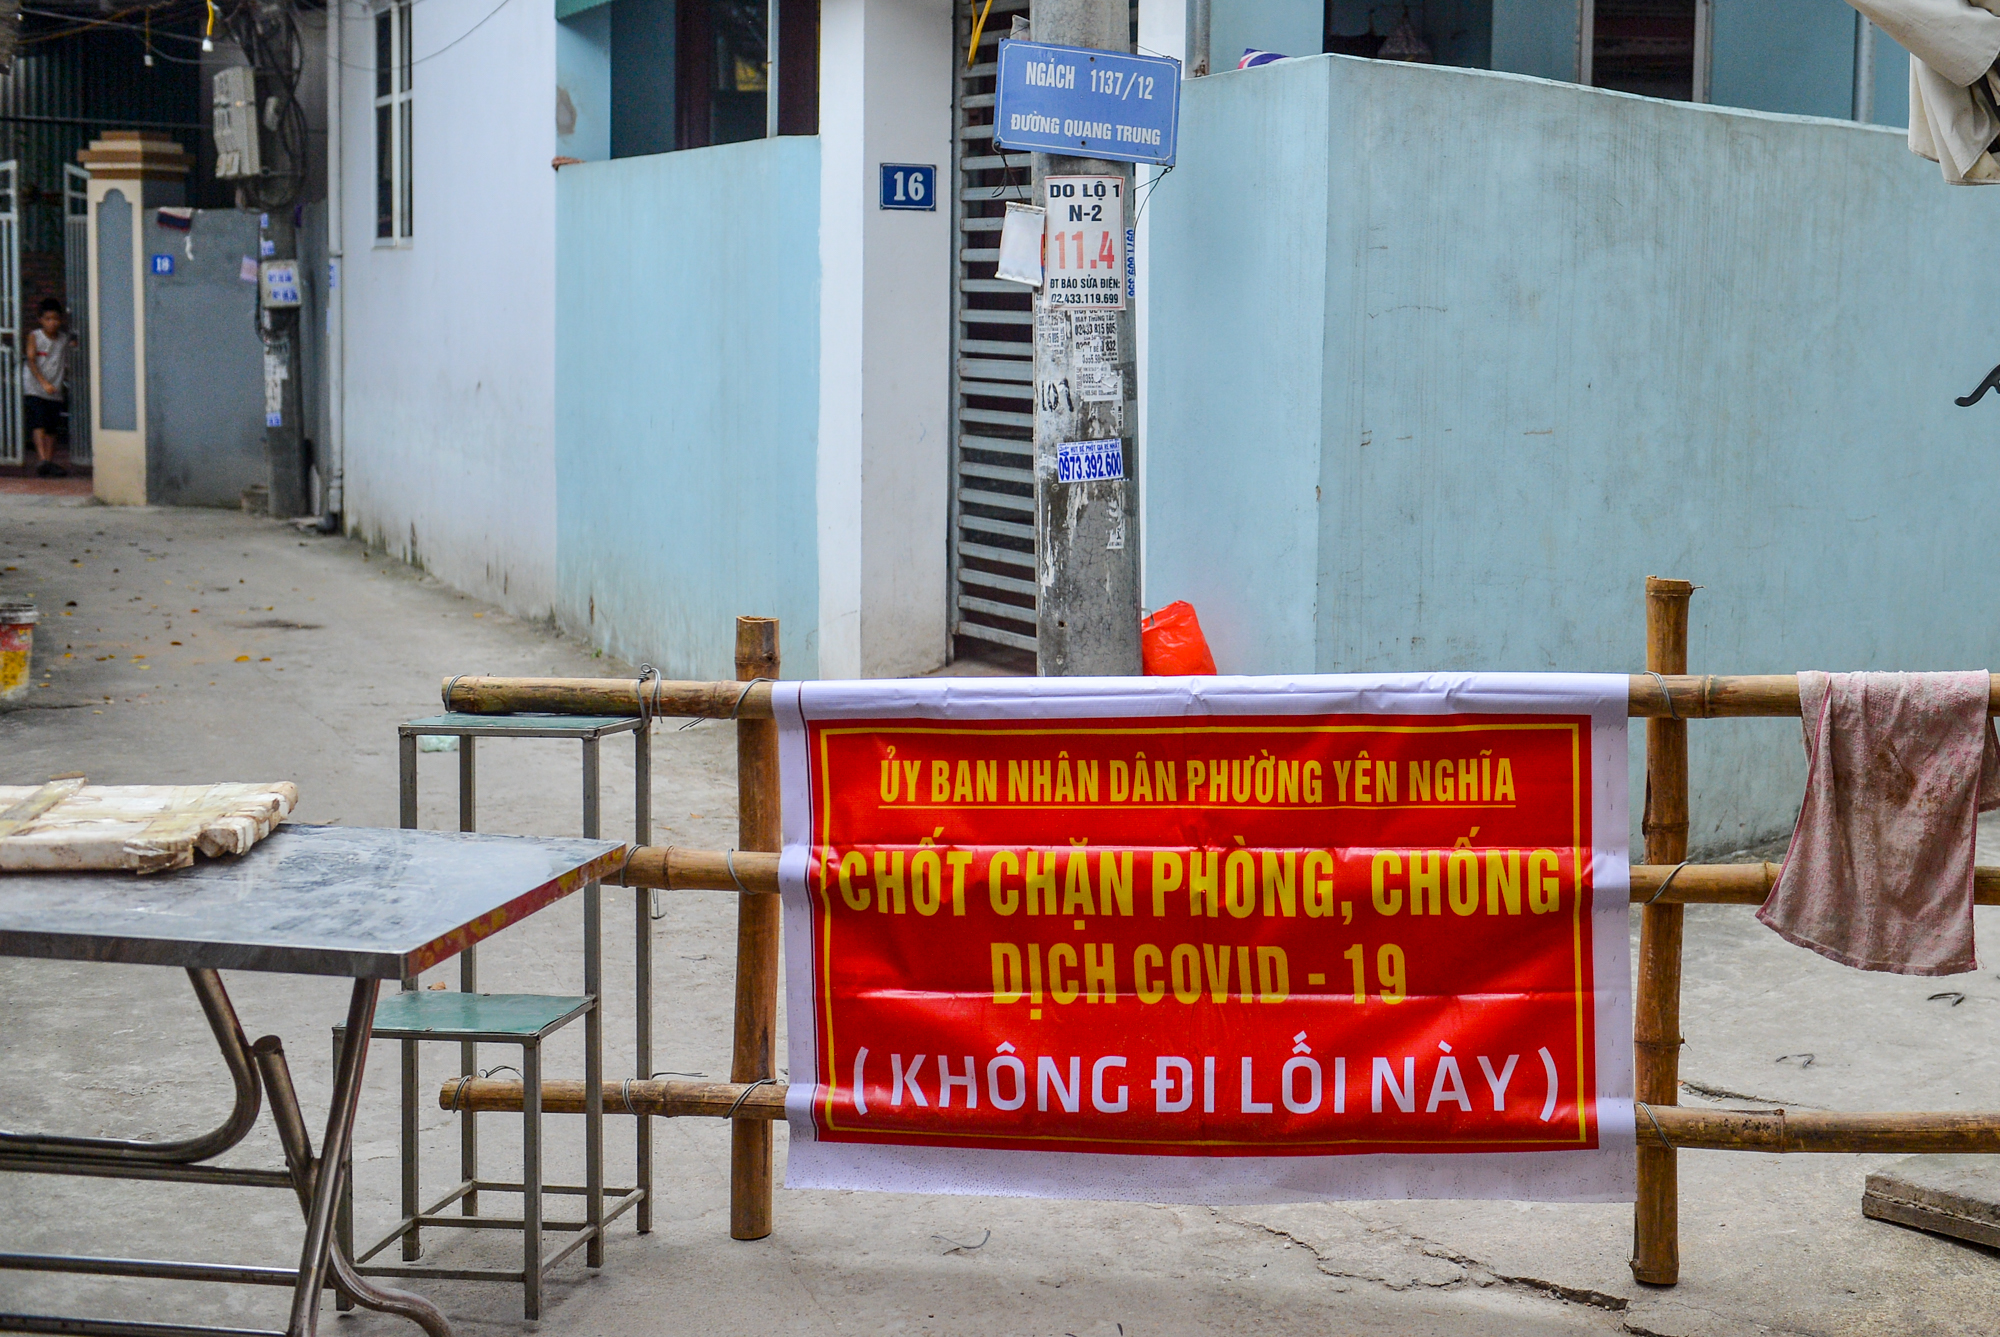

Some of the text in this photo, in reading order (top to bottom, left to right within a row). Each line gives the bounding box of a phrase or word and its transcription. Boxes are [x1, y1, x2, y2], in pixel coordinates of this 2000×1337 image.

[1025, 58, 1154, 100] NGÁCH 1137/12
[1010, 110, 1161, 145] ĐƯỜNG QUANG TRUNG
[893, 171, 925, 201] 16
[1049, 180, 1120, 201] DO LỘ 1
[1069, 204, 1102, 222] N-2
[1055, 230, 1115, 270] 11.4
[1050, 273, 1120, 291] ĐT BÁO SỬA ĐIỆN:
[1051, 293, 1119, 304] 02.433.119.699
[1059, 451, 1122, 481] 0973.392.600
[880, 745, 1516, 804] ỦY BAN NHÂN DÂN PHƯỜNG YÊN NGHĨA
[838, 826, 1560, 930] CHỐT CHẶN PHÒNG, CHỐNG
[990, 942, 1406, 1020] DỊCH COVID - 19
[890, 1041, 1129, 1113] KHÔNG
[1150, 1056, 1215, 1113] ĐI
[1241, 1030, 1346, 1114] LỐI
[1371, 1040, 1520, 1113] NÀY
